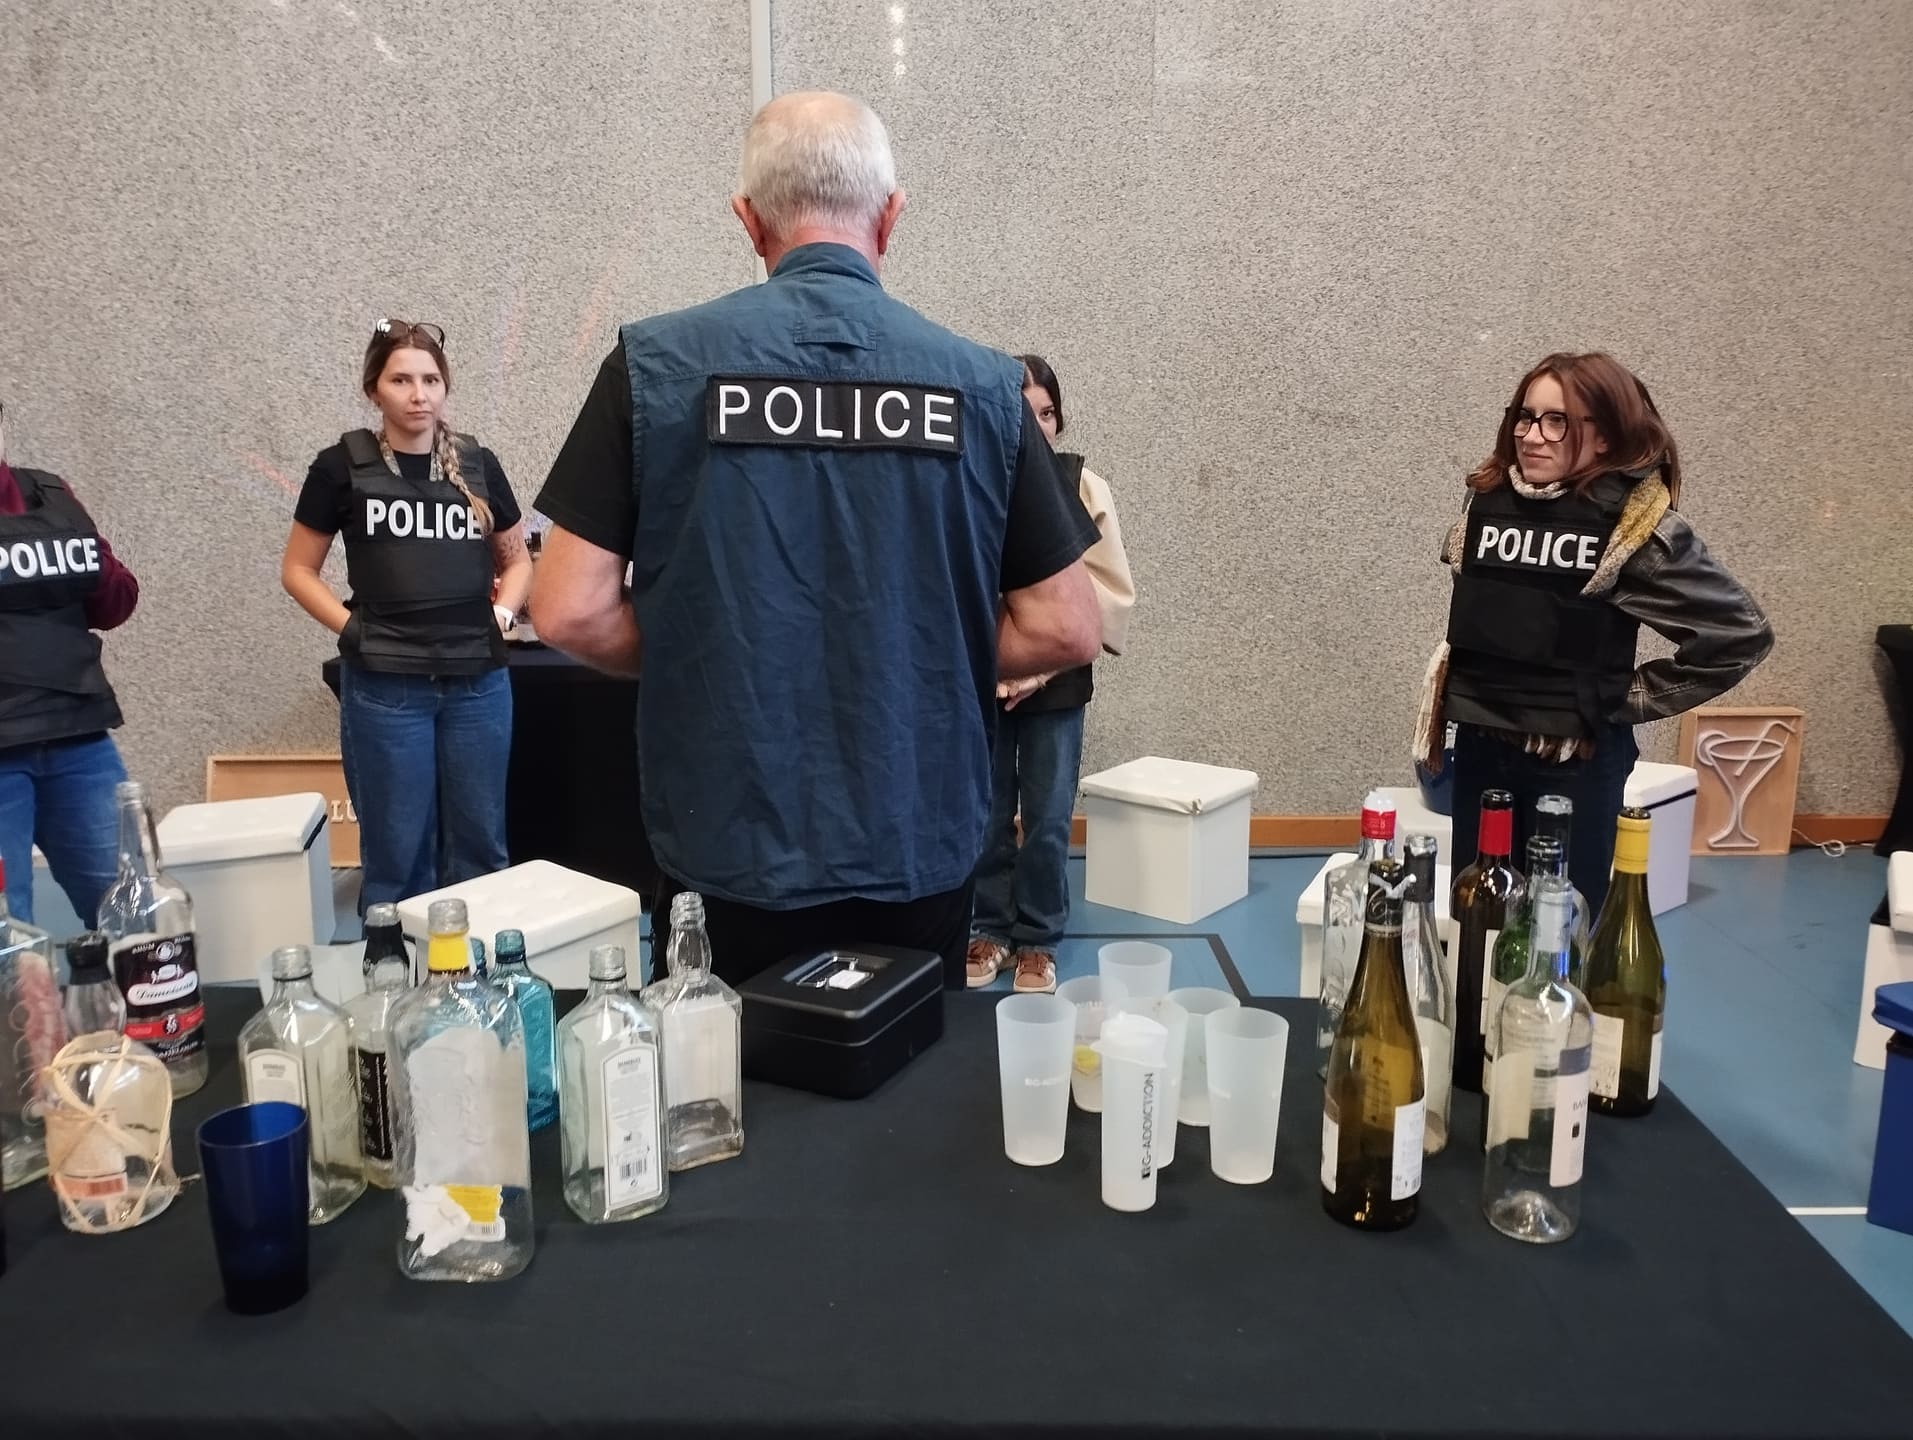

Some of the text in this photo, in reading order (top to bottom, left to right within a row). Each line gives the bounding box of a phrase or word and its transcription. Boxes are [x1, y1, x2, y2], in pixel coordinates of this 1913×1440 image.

[719, 384, 955, 444] POLICE
[366, 498, 483, 541] POLICE
[1477, 525, 1600, 571] POLICE
